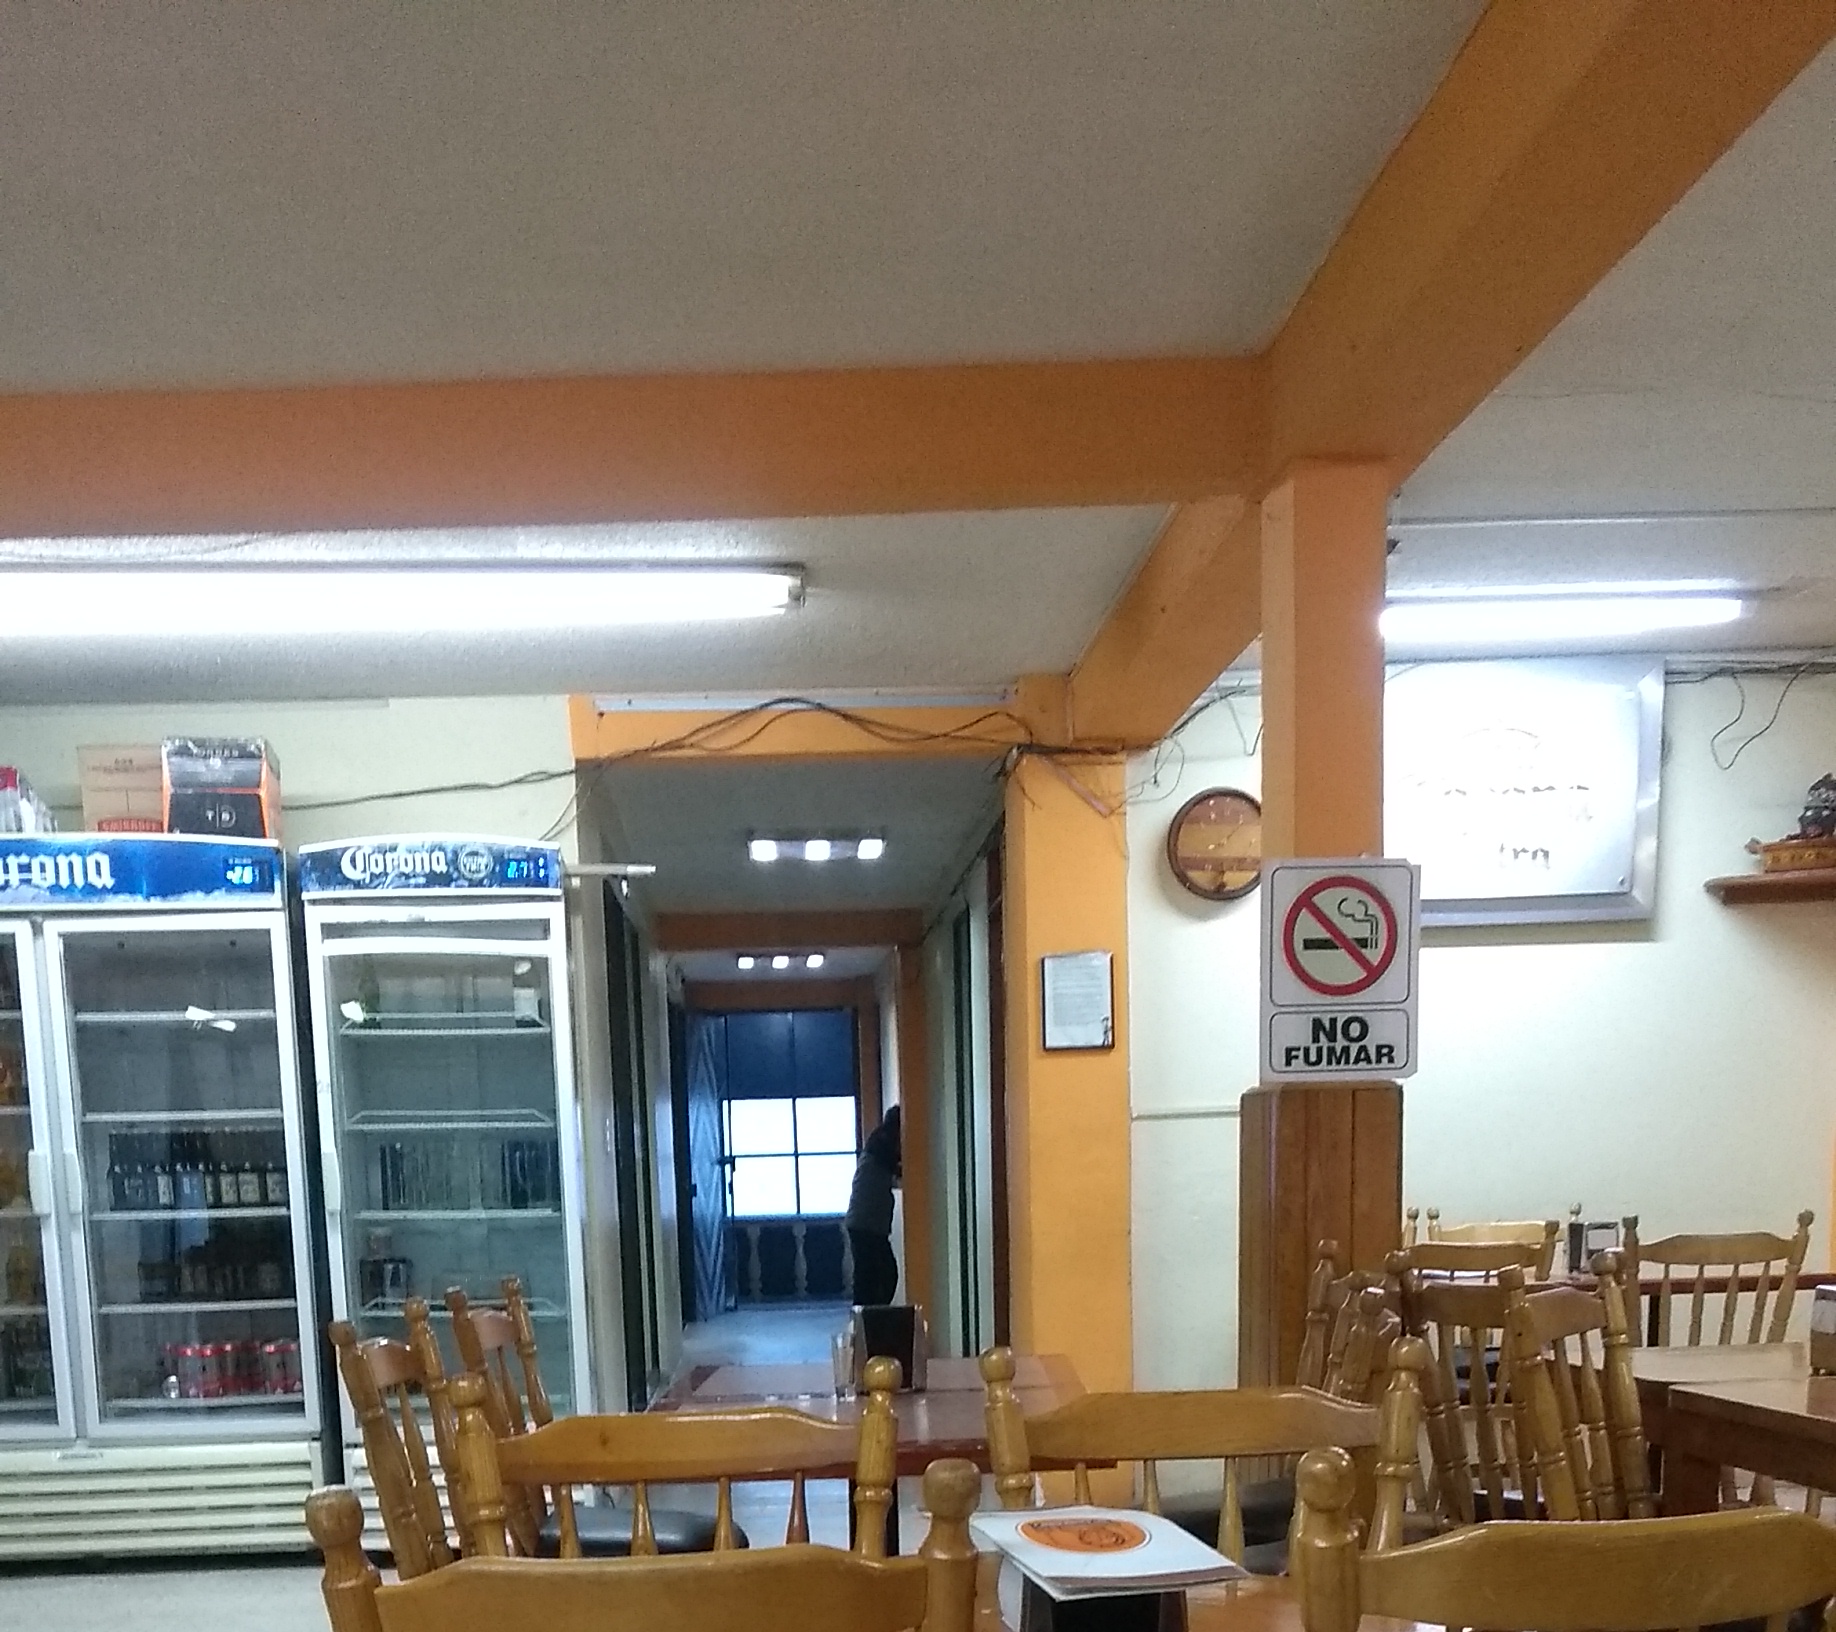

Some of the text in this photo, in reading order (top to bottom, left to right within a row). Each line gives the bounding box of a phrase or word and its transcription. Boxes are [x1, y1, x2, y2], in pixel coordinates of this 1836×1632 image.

[0, 852, 115, 889] rona
[341, 846, 448, 883] Corona
[1311, 1016, 1369, 1044] NO
[1284, 1044, 1396, 1068] FUMAR
